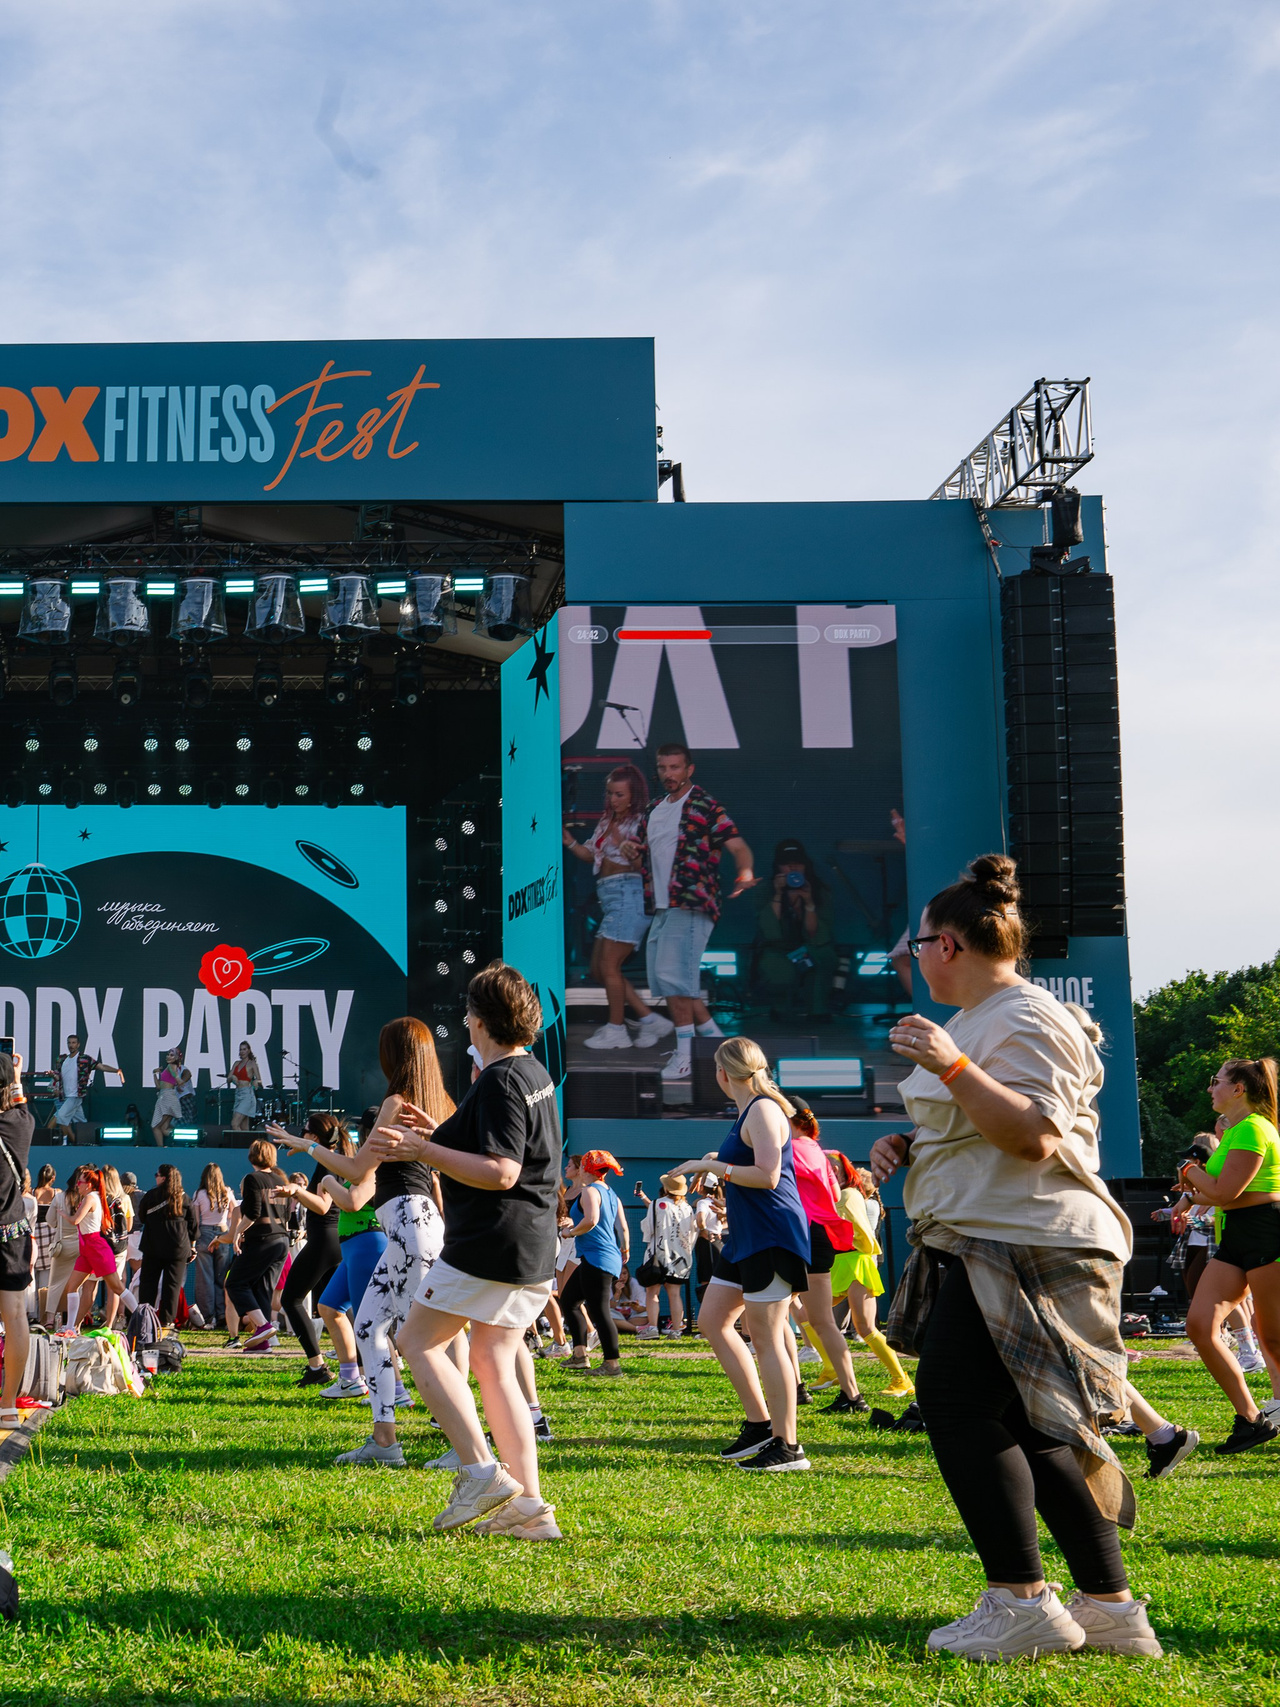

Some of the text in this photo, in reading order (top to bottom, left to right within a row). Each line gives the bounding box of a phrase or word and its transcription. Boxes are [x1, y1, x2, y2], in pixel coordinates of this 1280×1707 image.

[103, 384, 276, 463] FITNESS
[263, 360, 441, 491] Fest
[850, 629, 871, 639] PARTY
[97, 901, 166, 925] музыка
[508, 886, 528, 922] DDX
[121, 914, 220, 945] объединяет
[142, 987, 355, 1091] PARTY
